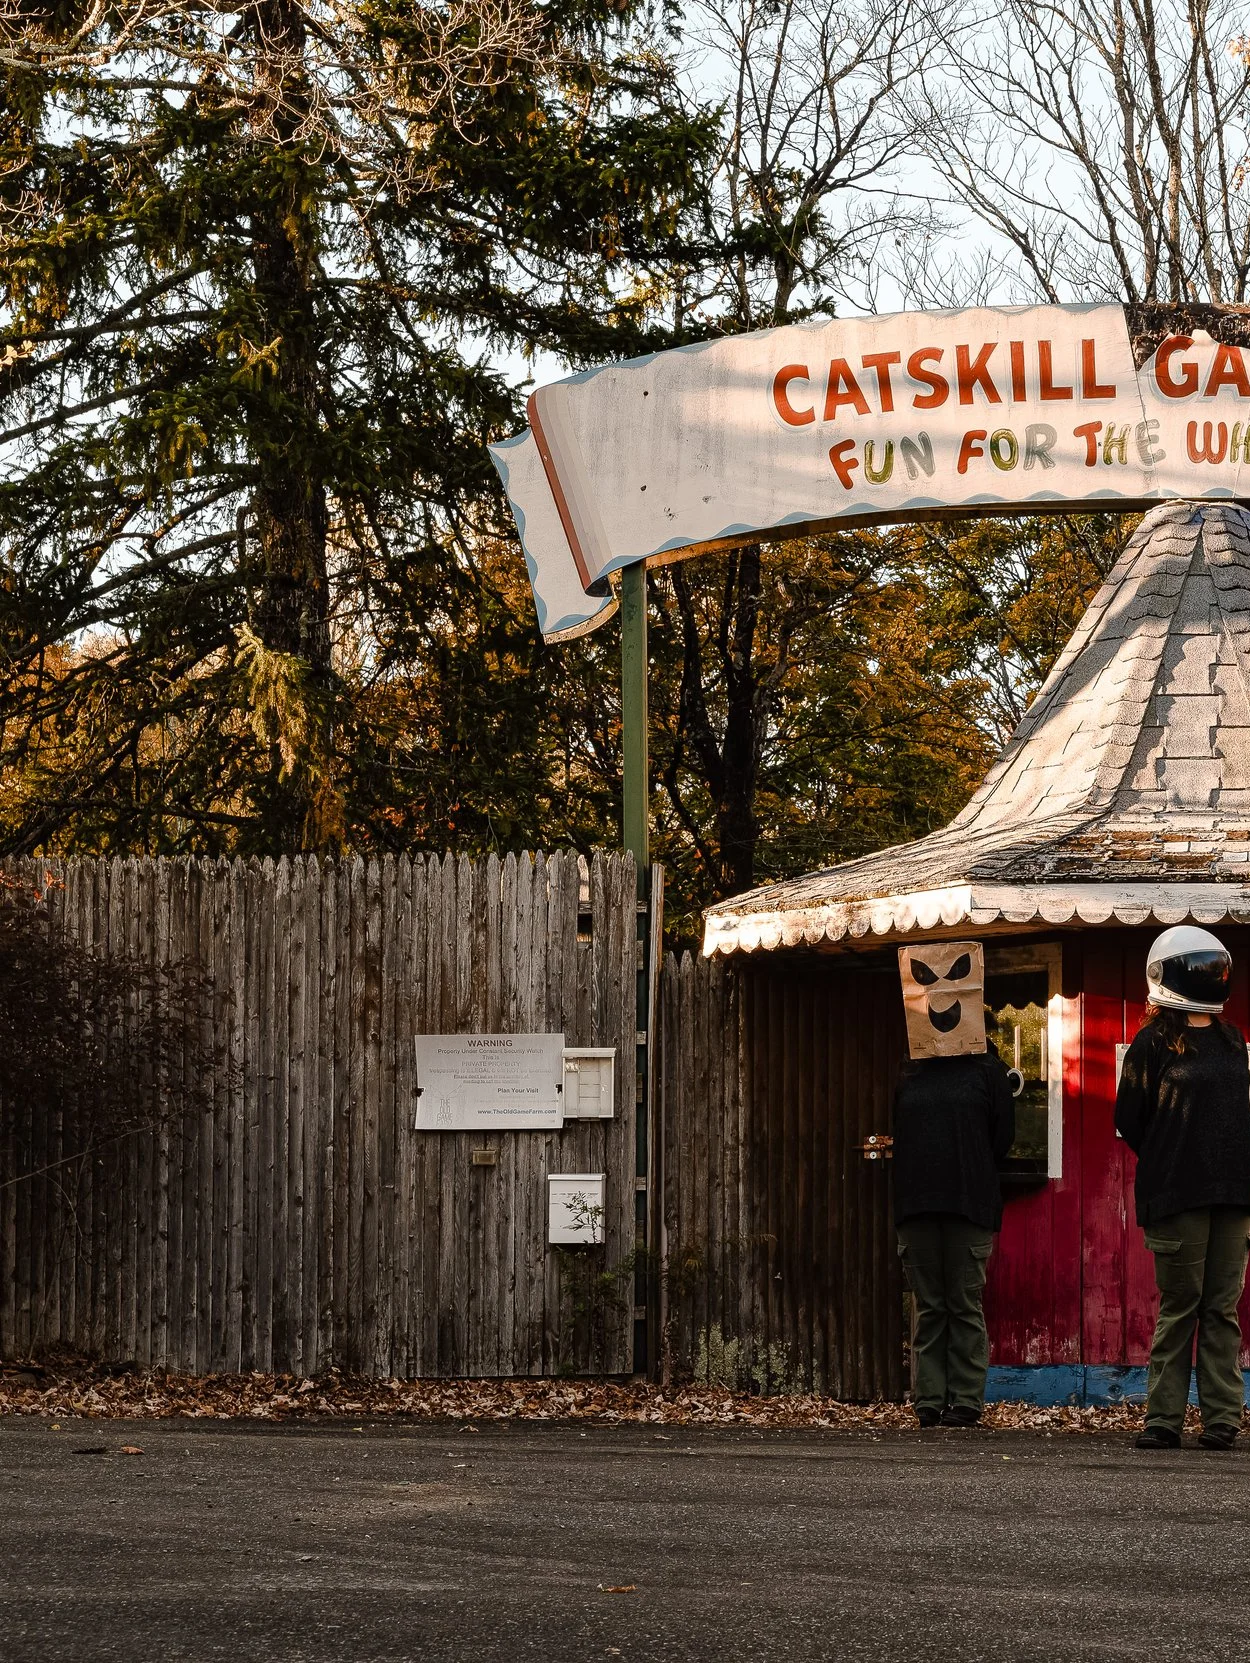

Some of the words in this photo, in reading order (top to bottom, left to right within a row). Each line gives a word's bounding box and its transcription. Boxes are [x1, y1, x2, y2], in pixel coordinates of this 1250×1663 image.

[772, 338, 1116, 426] CATSKILL
[829, 431, 936, 490] FUN
[957, 422, 1058, 475] FOR
[1073, 419, 1166, 467] THE
